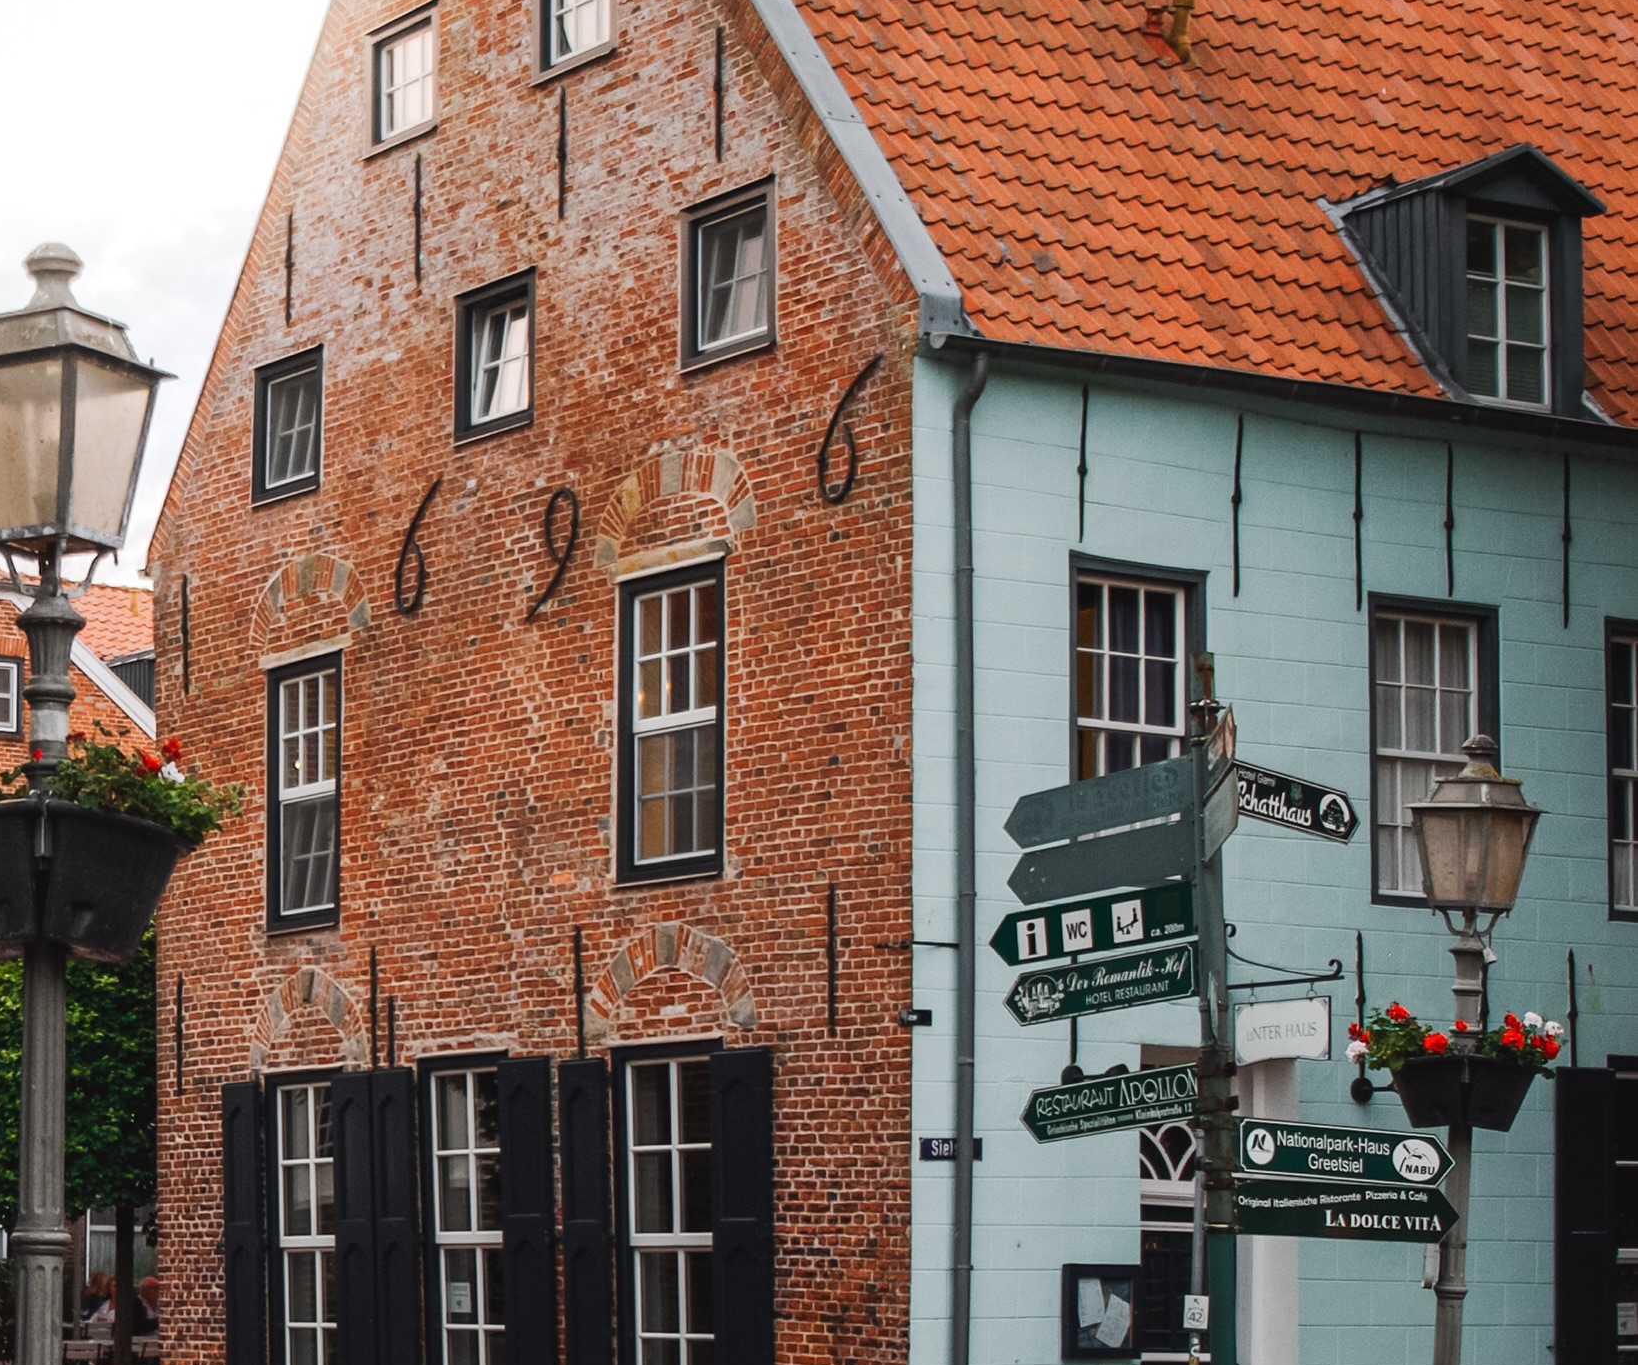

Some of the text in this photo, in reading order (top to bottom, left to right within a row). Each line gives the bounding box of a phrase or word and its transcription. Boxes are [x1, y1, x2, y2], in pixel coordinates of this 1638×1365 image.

[1238, 768, 1256, 781] Hotel
[1238, 781, 1311, 826] Schatthaus
[1066, 921, 1087, 940] WC
[1066, 972, 1088, 991] Der
[1085, 980, 1170, 1005] HOTEL RESTAURANT
[1285, 1022, 1317, 1038] HAUS
[1036, 1068, 1198, 1118] RESTAURANT APOLLON
[931, 1139, 958, 1157] Siel
[1276, 1130, 1391, 1155] Nationalpark-Haus
[1308, 1153, 1363, 1173] Greetsiel
[1405, 1164, 1435, 1176] NABU
[1238, 1195, 1271, 1208] Original
[1319, 1192, 1361, 1204] Ristorante
[1365, 1190, 1397, 1200] Pizzeria
[1399, 1191, 1406, 1200] &
[1408, 1191, 1428, 1202] Café
[1324, 1209, 1441, 1231] LA DOLCE VITA
[1189, 1312, 1202, 1322] 42
